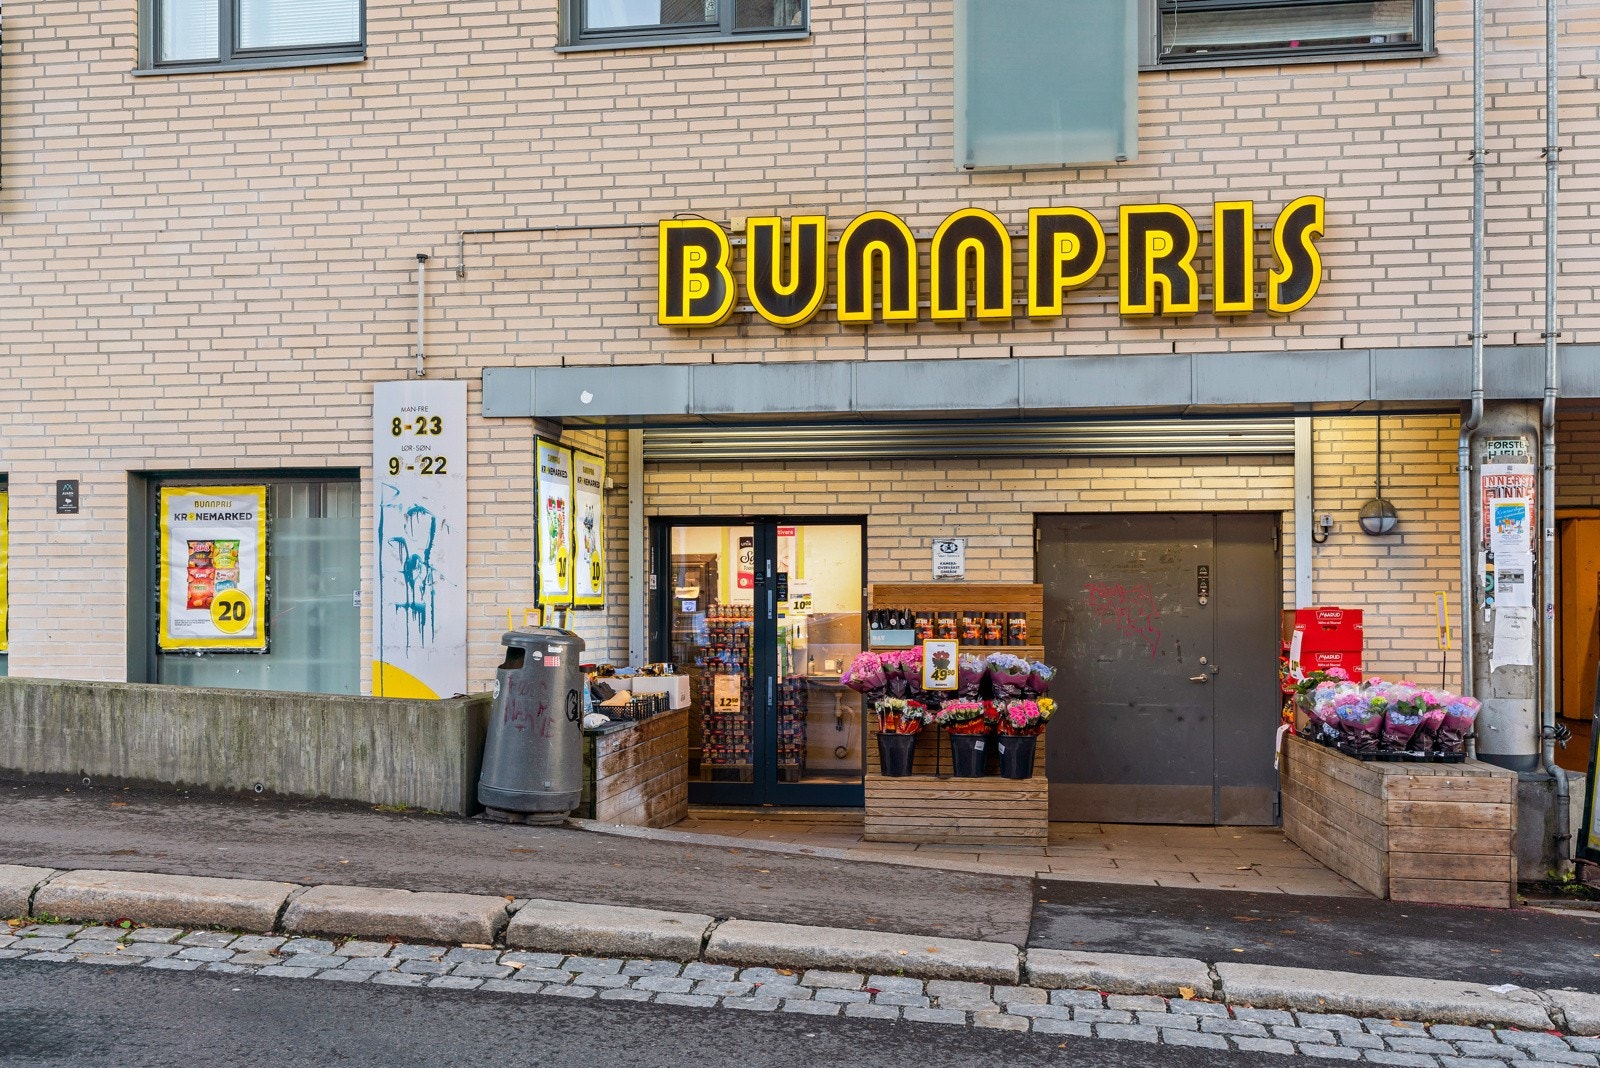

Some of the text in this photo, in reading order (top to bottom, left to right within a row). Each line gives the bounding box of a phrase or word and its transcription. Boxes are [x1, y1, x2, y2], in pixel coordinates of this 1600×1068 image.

[658, 195, 1325, 328] BUNNPRIS
[400, 405, 429, 413] MAN-FRE
[194, 500, 232, 508] BUNNPRIS
[218, 601, 246, 621] 20
